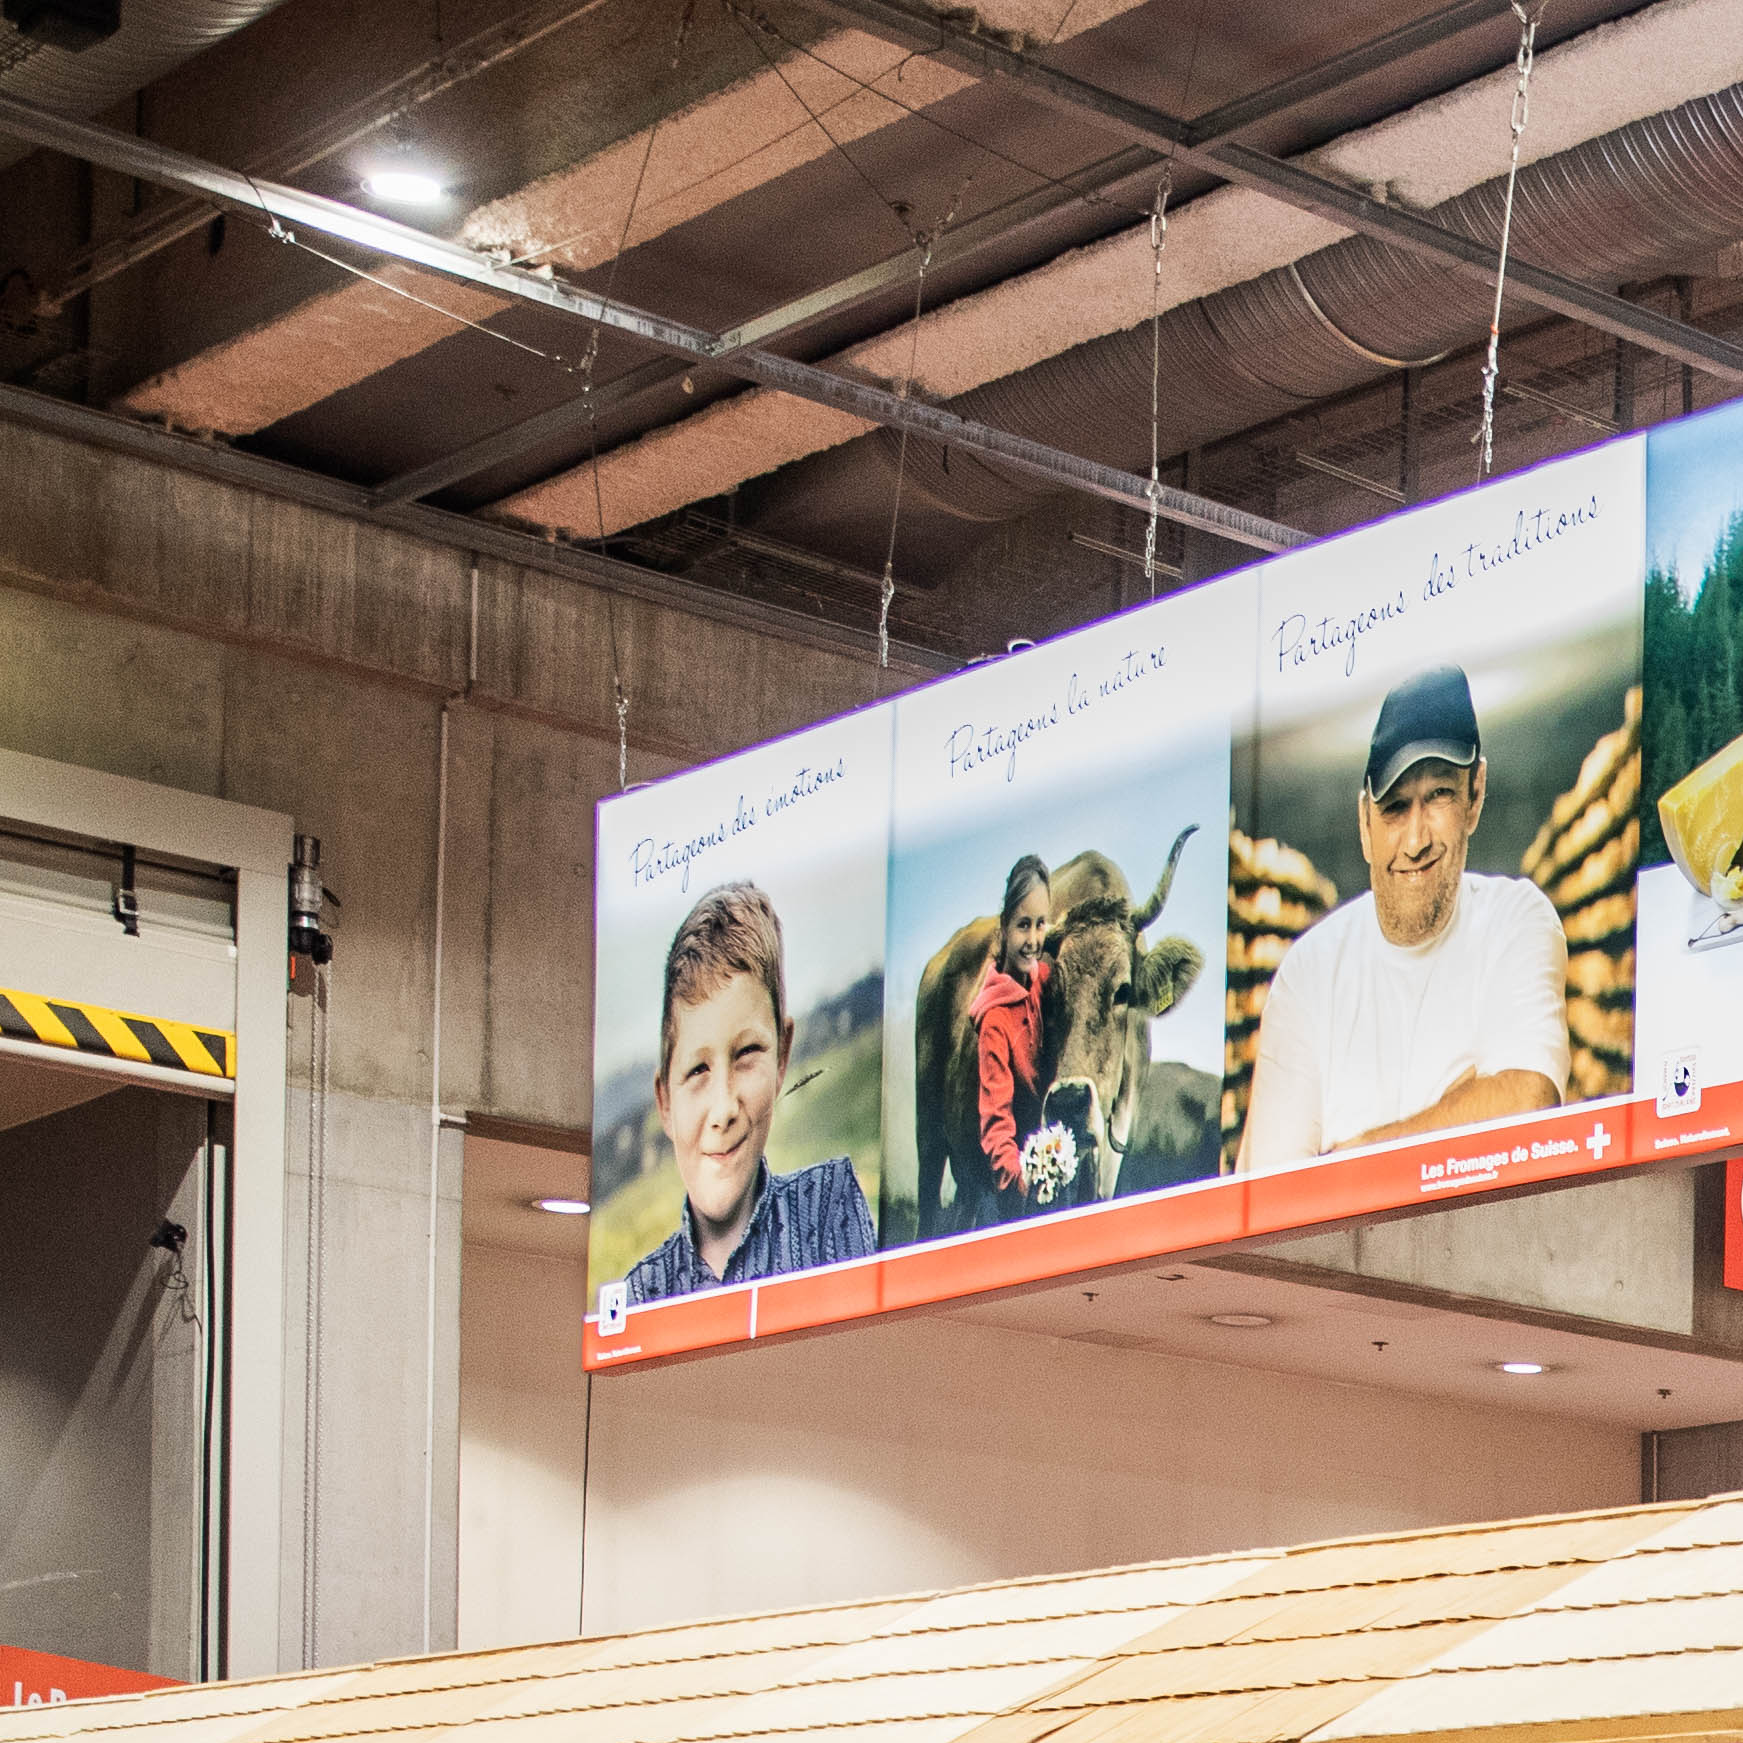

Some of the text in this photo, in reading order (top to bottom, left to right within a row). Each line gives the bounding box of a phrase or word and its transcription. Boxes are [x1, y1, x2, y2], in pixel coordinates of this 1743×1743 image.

[1272, 495, 1602, 677] Partageons des traditions
[944, 646, 1167, 783] Partageons la nature
[628, 758, 848, 894] Partageons des émotions
[1421, 1163, 1444, 1181] Les
[1446, 1152, 1509, 1175] Fromages
[1511, 1145, 1529, 1163] de
